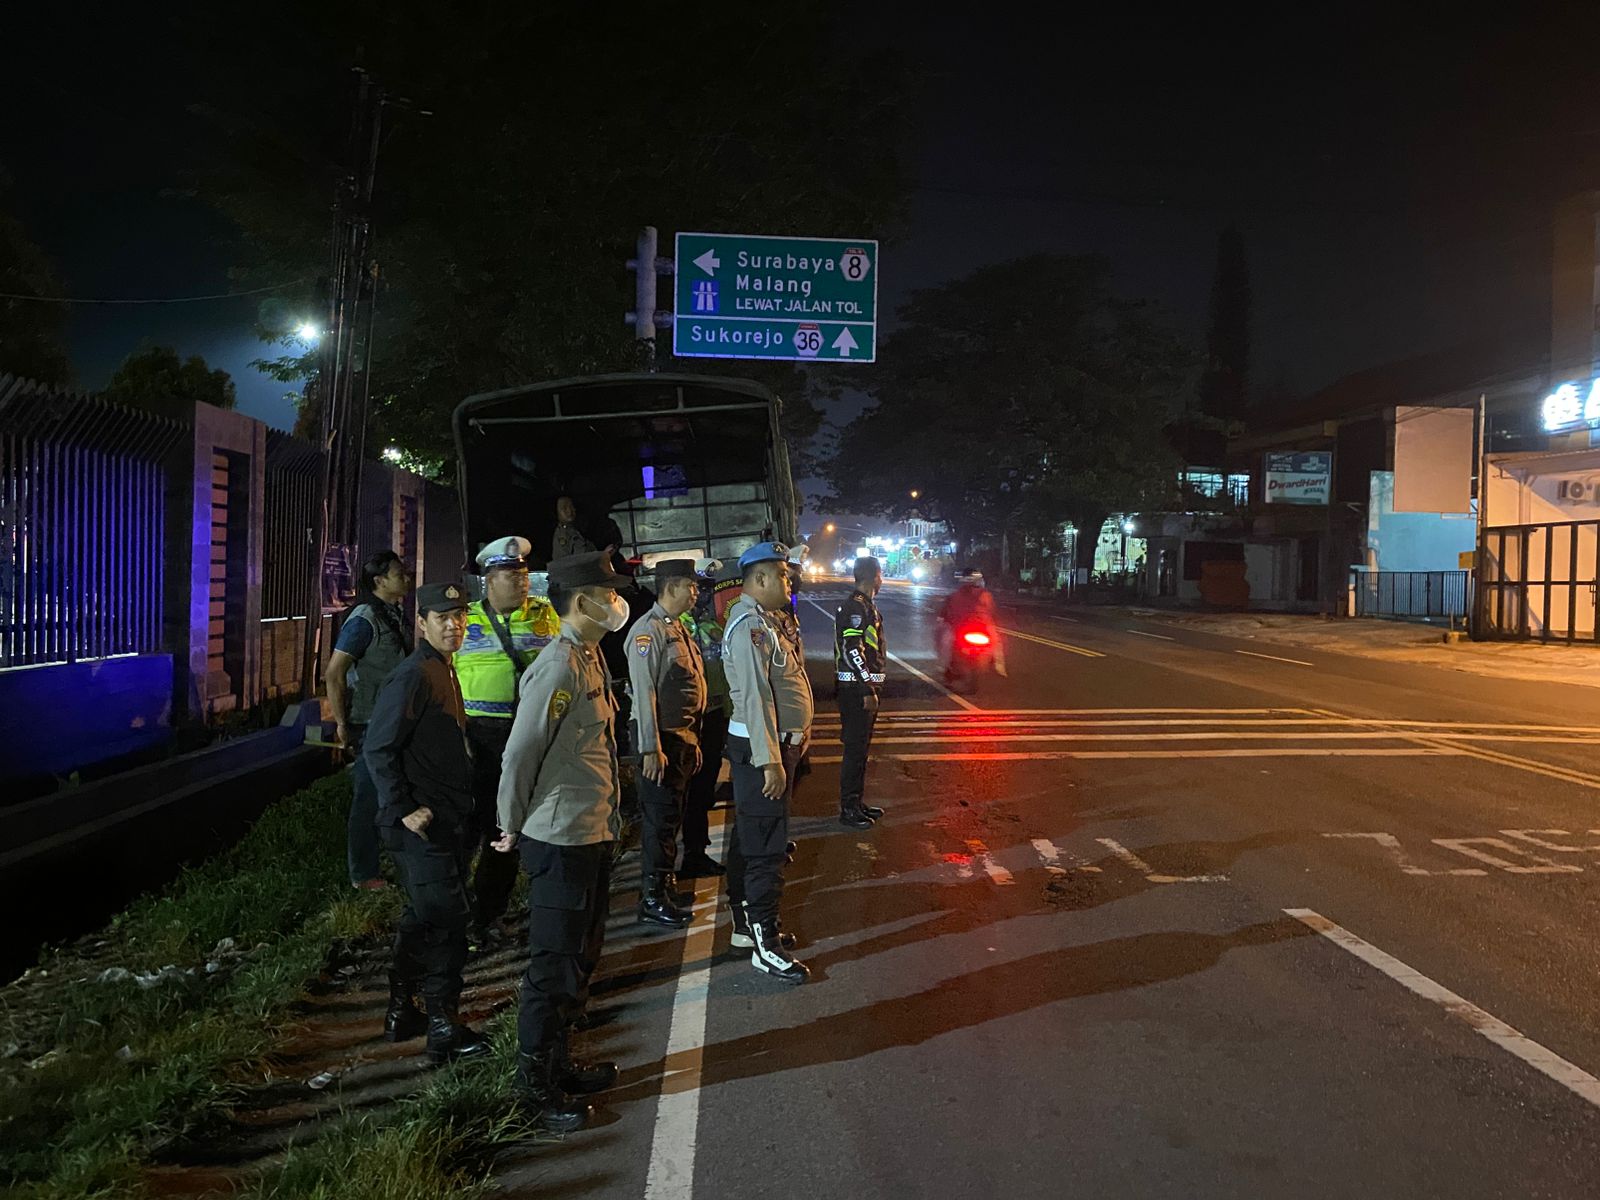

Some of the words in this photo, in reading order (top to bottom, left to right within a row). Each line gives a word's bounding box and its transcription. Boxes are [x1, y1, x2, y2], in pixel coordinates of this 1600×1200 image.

[738, 251, 835, 274] Surabaya
[848, 255, 862, 279] 8
[736, 275, 813, 298] Malang
[735, 298, 781, 311] LEWAT
[784, 299, 832, 313] JALAN
[835, 301, 863, 314] TOL
[691, 325, 784, 349] Sukorejo
[796, 331, 820, 351] 36
